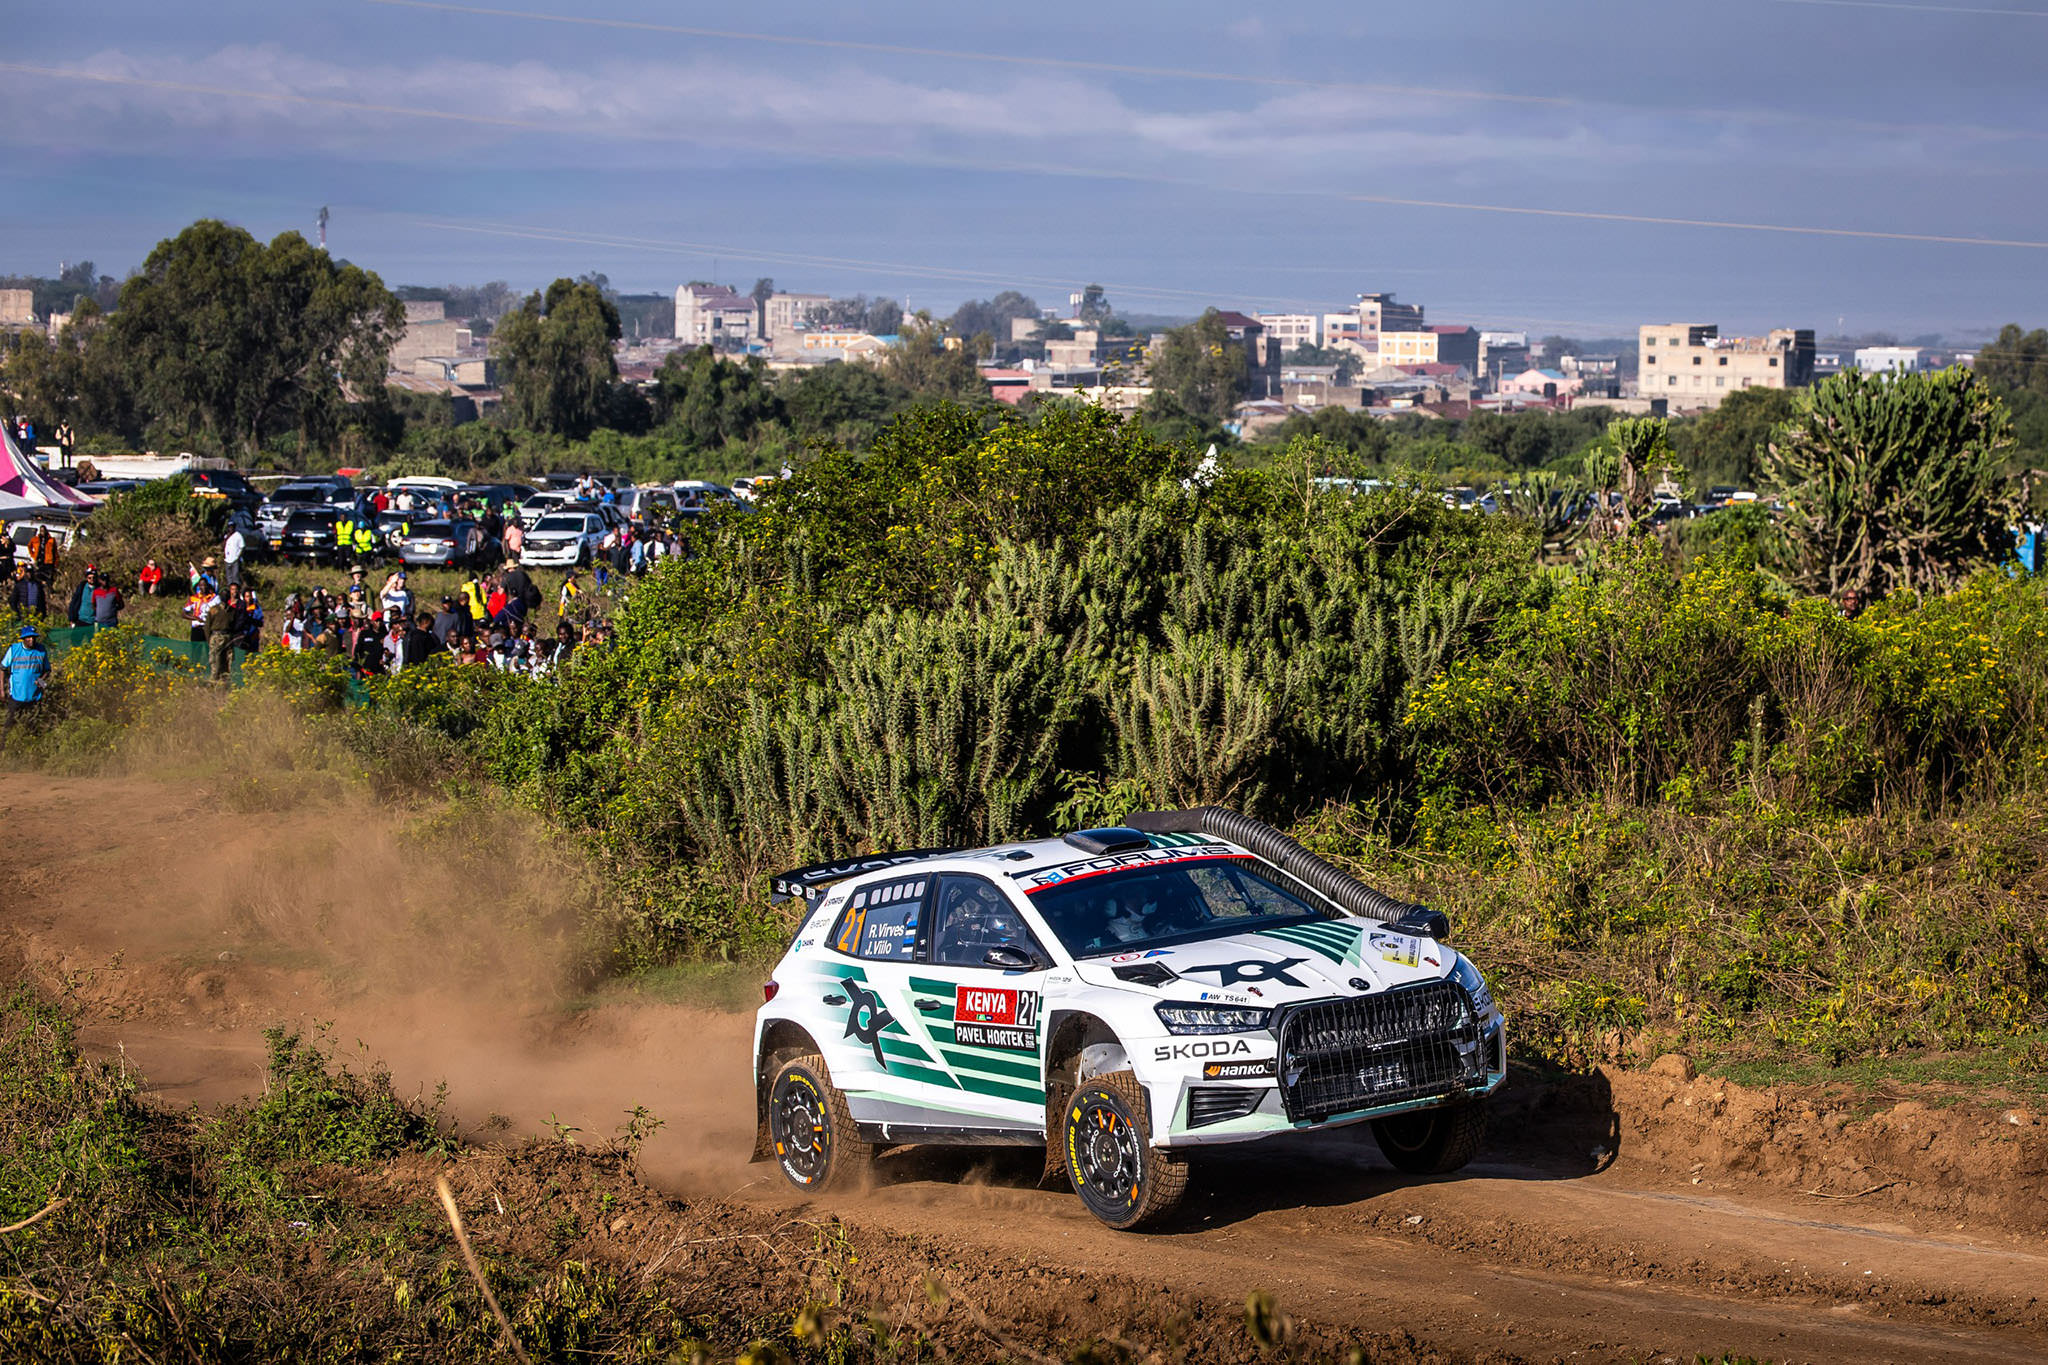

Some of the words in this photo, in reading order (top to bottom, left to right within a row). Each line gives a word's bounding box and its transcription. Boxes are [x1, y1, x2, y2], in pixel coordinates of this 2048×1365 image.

[1062, 846, 1233, 876] FORUM8
[837, 907, 867, 953] 21
[868, 923, 905, 939] R.Virves
[966, 991, 1007, 1014] KENYA
[1018, 991, 1036, 1026] 21
[956, 1026, 986, 1044] PAVEL
[987, 1029, 1025, 1047] HORTEK
[1154, 1039, 1252, 1062] SKODA
